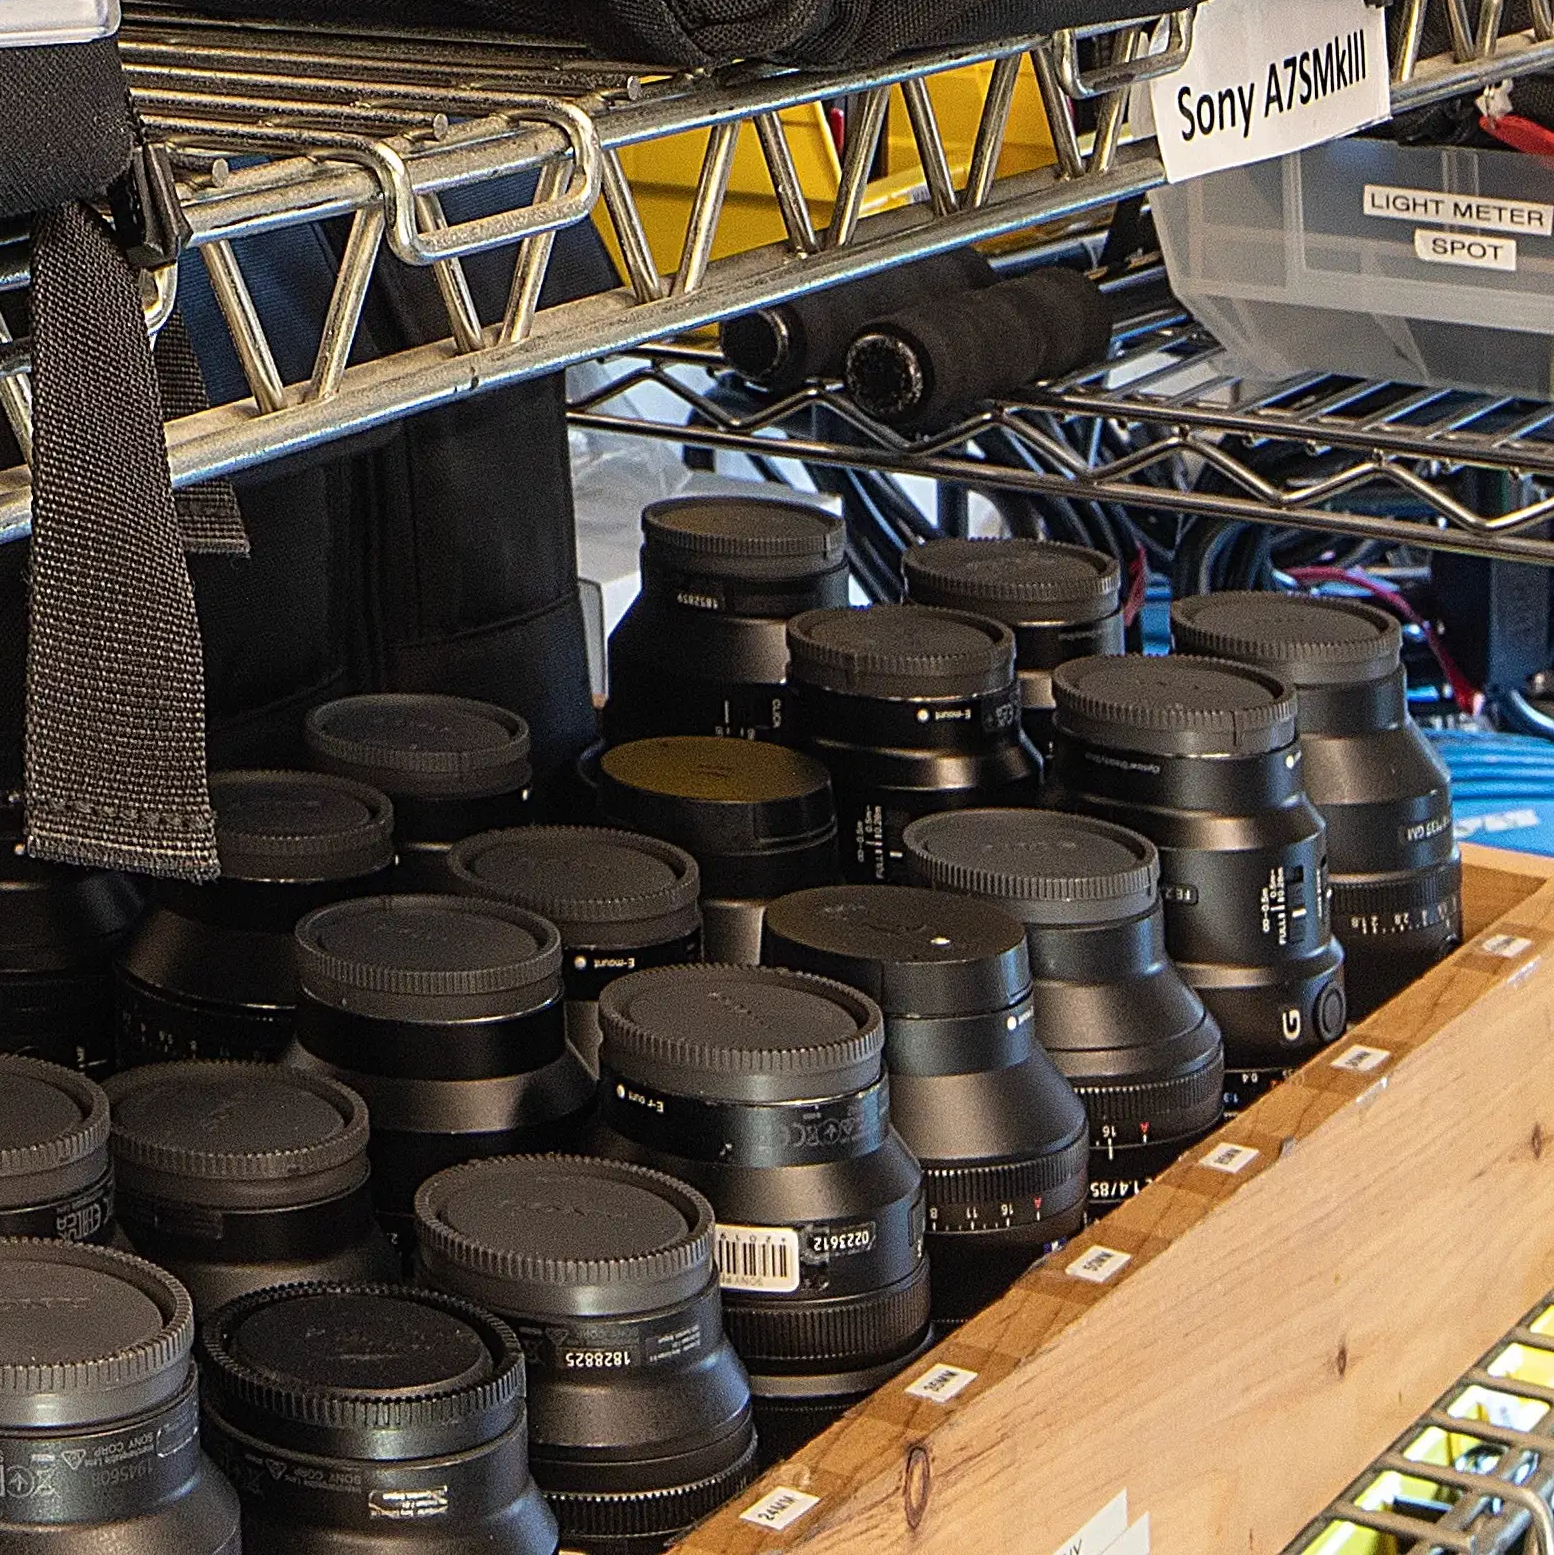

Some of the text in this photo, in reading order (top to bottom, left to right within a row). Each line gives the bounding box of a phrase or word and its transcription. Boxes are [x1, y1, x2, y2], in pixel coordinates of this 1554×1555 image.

[1177, 28, 1367, 141] Sony A7SMkIII
[1371, 192, 1544, 227] LIGHT METER
[1432, 237, 1503, 261] SPOT
[594, 957, 636, 970] E-mount
[813, 1230, 870, 1251] 0223612
[565, 1351, 631, 1368] 1828825
